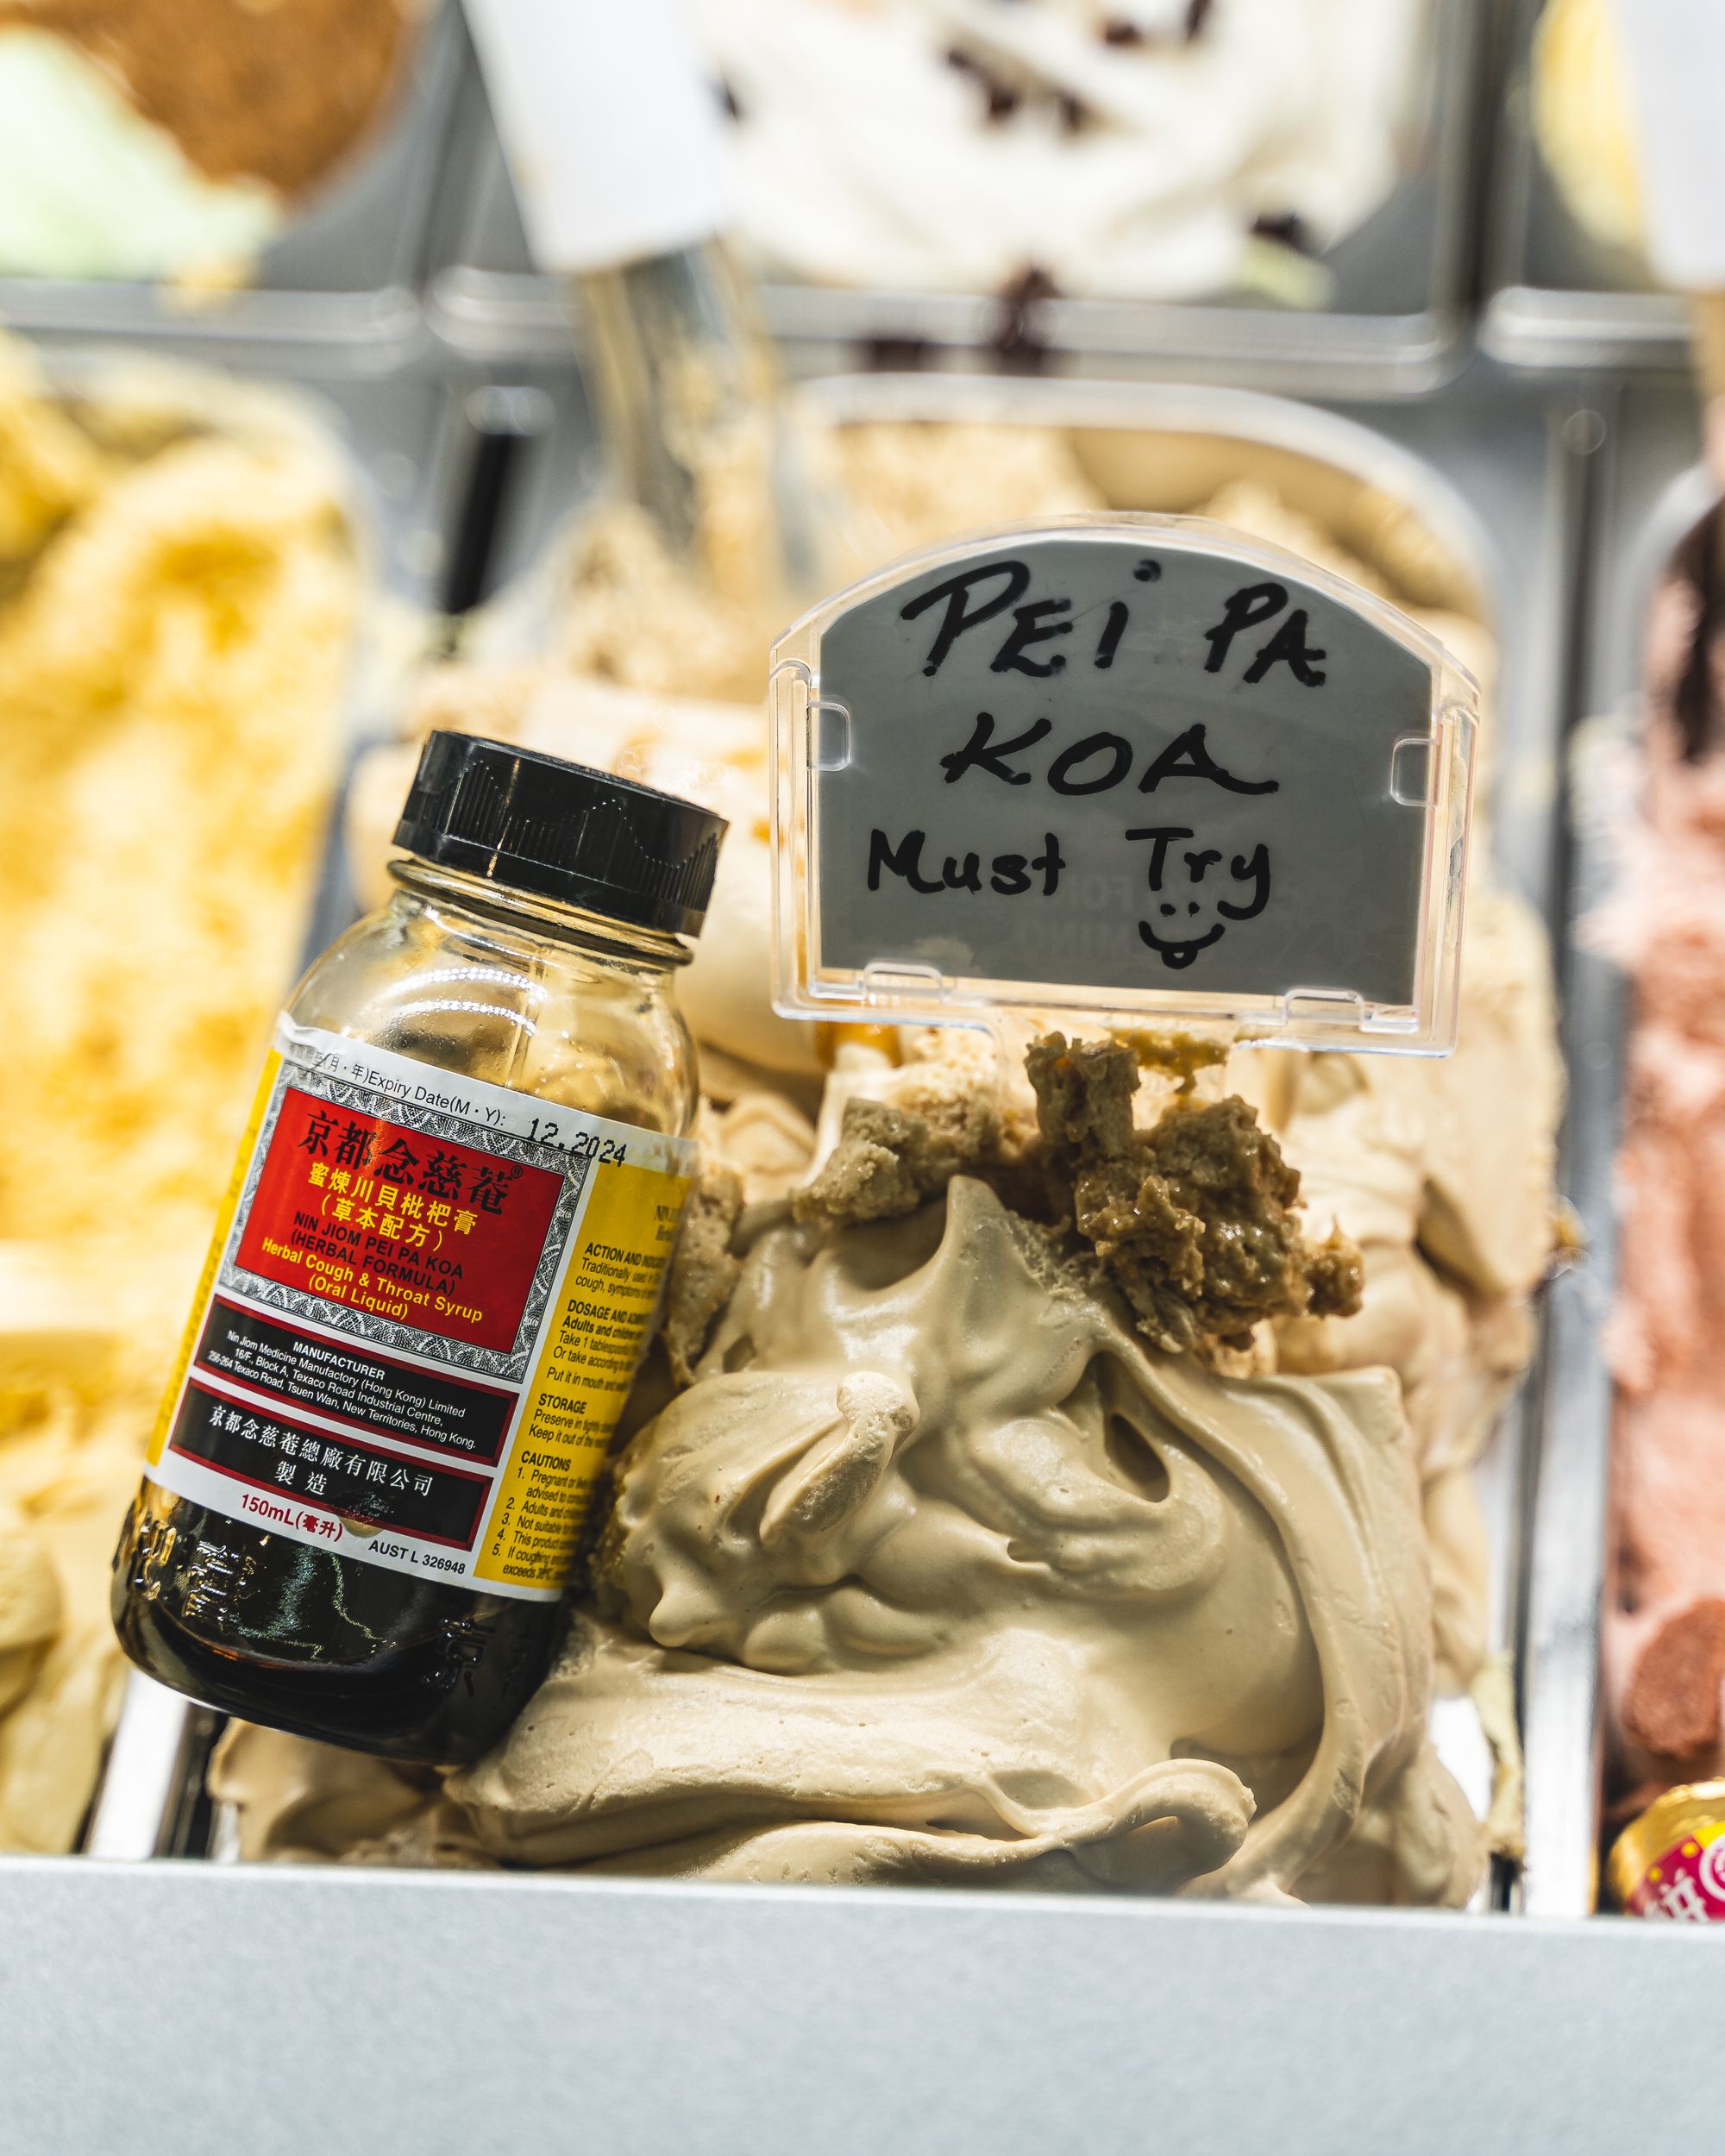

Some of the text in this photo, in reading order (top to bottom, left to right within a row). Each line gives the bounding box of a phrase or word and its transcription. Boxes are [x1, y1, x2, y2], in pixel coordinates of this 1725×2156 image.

[1204, 582, 1326, 686] PA
[940, 711, 1279, 796] KOA
[868, 829, 1065, 896] Must
[1126, 827, 1272, 920] Try
[525, 1118, 626, 1168] 12.2024
[308, 1162, 477, 1234] 蜜煉川貝枇杷膏
[293, 1211, 462, 1279] NIN JIOM PEI PA KOA
[584, 1242, 624, 1262] ACTION
[291, 1228, 455, 1300] (HERBAL FORMULA)
[261, 1237, 482, 1323] Herbal Cough & Throat Syrup
[574, 1275, 605, 1293] cough,
[309, 1273, 407, 1319] (Oral Liquid)
[567, 1299, 611, 1320] DOSAGE
[561, 1314, 594, 1333] Adults
[595, 1325, 612, 1337] and
[559, 1329, 580, 1346] Take
[583, 1336, 588, 1348] 1
[292, 1341, 385, 1380] MANUFACTURER
[553, 1345, 567, 1359] Or
[567, 1350, 586, 1364] take
[227, 1330, 466, 1417] Nin Jiom Medicine Manufactory (Hong Kong) Limited
[546, 1366, 564, 1382] Put
[564, 1370, 572, 1383] it
[572, 1372, 580, 1385] in
[255, 1356, 279, 1372] Block
[279, 1365, 288, 1377] A,
[293, 1369, 325, 1388] Texaco
[327, 1382, 355, 1399] Road
[357, 1391, 405, 1413] Industrial
[406, 1407, 442, 1426] Centre,
[234, 1360, 259, 1379] Texaco
[260, 1371, 284, 1390] Road,
[288, 1381, 313, 1399] Tsuen
[317, 1391, 339, 1409] Wan,
[342, 1401, 366, 1415] New
[368, 1408, 417, 1433] Territories,
[420, 1424, 447, 1442] Hong
[448, 1432, 475, 1450] Kong.
[538, 1393, 586, 1414] STORAGE
[533, 1407, 574, 1428] Preserve
[528, 1423, 554, 1443] Keep
[555, 1429, 562, 1442] it
[561, 1433, 576, 1445] out
[209, 1405, 432, 1496] 京都念慈菴總廠有限公司
[521, 1450, 571, 1471] CAUTIONS
[517, 1466, 524, 1479] 1.
[530, 1469, 568, 1488] Pregnant
[525, 1486, 559, 1502] advised
[505, 1496, 515, 1509] 2.
[520, 1500, 549, 1516] Adults
[242, 1494, 348, 1542] 150mL(毫升)
[501, 1512, 510, 1525] 3.
[516, 1514, 534, 1530] Not
[497, 1528, 505, 1540] 4.
[513, 1530, 531, 1545] This
[367, 1539, 466, 1574] AUST L 326948
[492, 1543, 500, 1556] 5.
[507, 1545, 516, 1558] If
